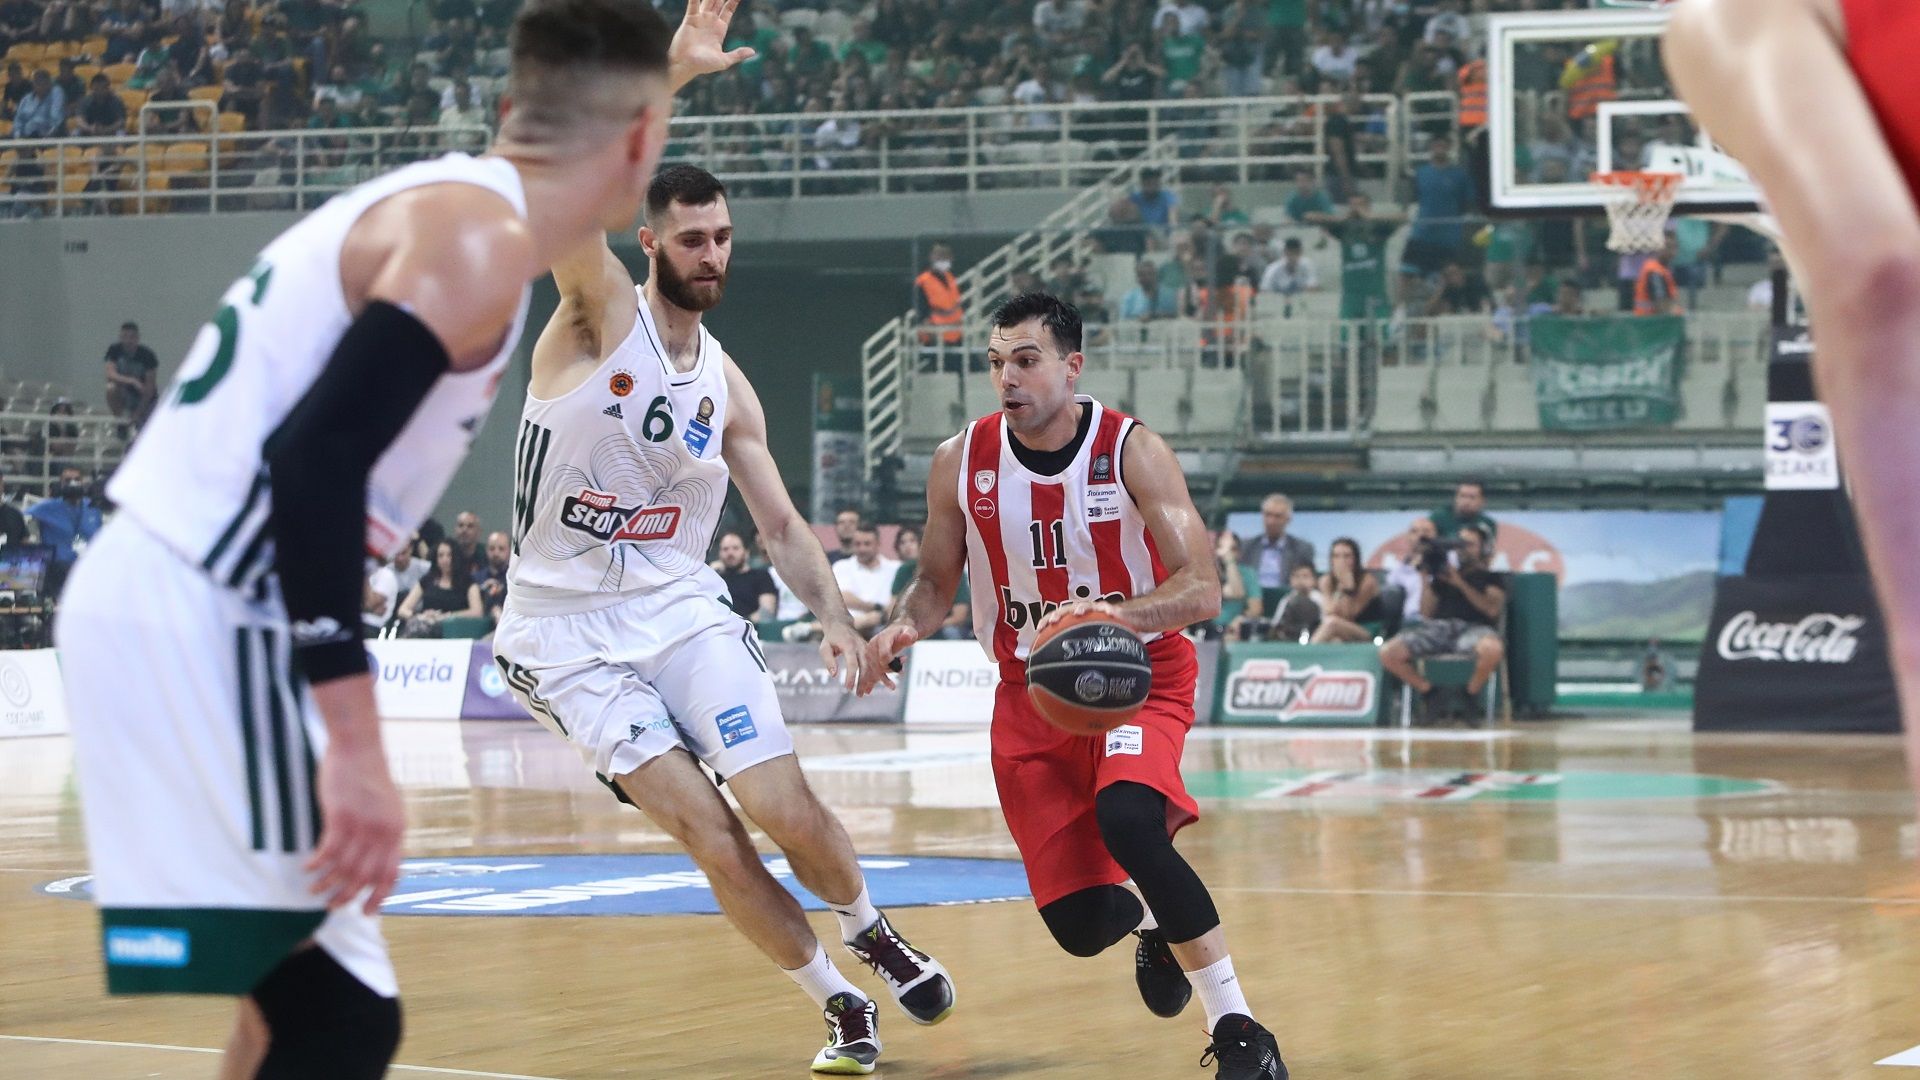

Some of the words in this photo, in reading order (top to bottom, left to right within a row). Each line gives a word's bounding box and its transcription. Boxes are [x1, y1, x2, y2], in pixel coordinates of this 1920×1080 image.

[642, 395, 674, 442] 6
[1029, 520, 1068, 568] 11
[1001, 585, 1126, 631] bw
[1061, 636, 1145, 661] SPALDING
